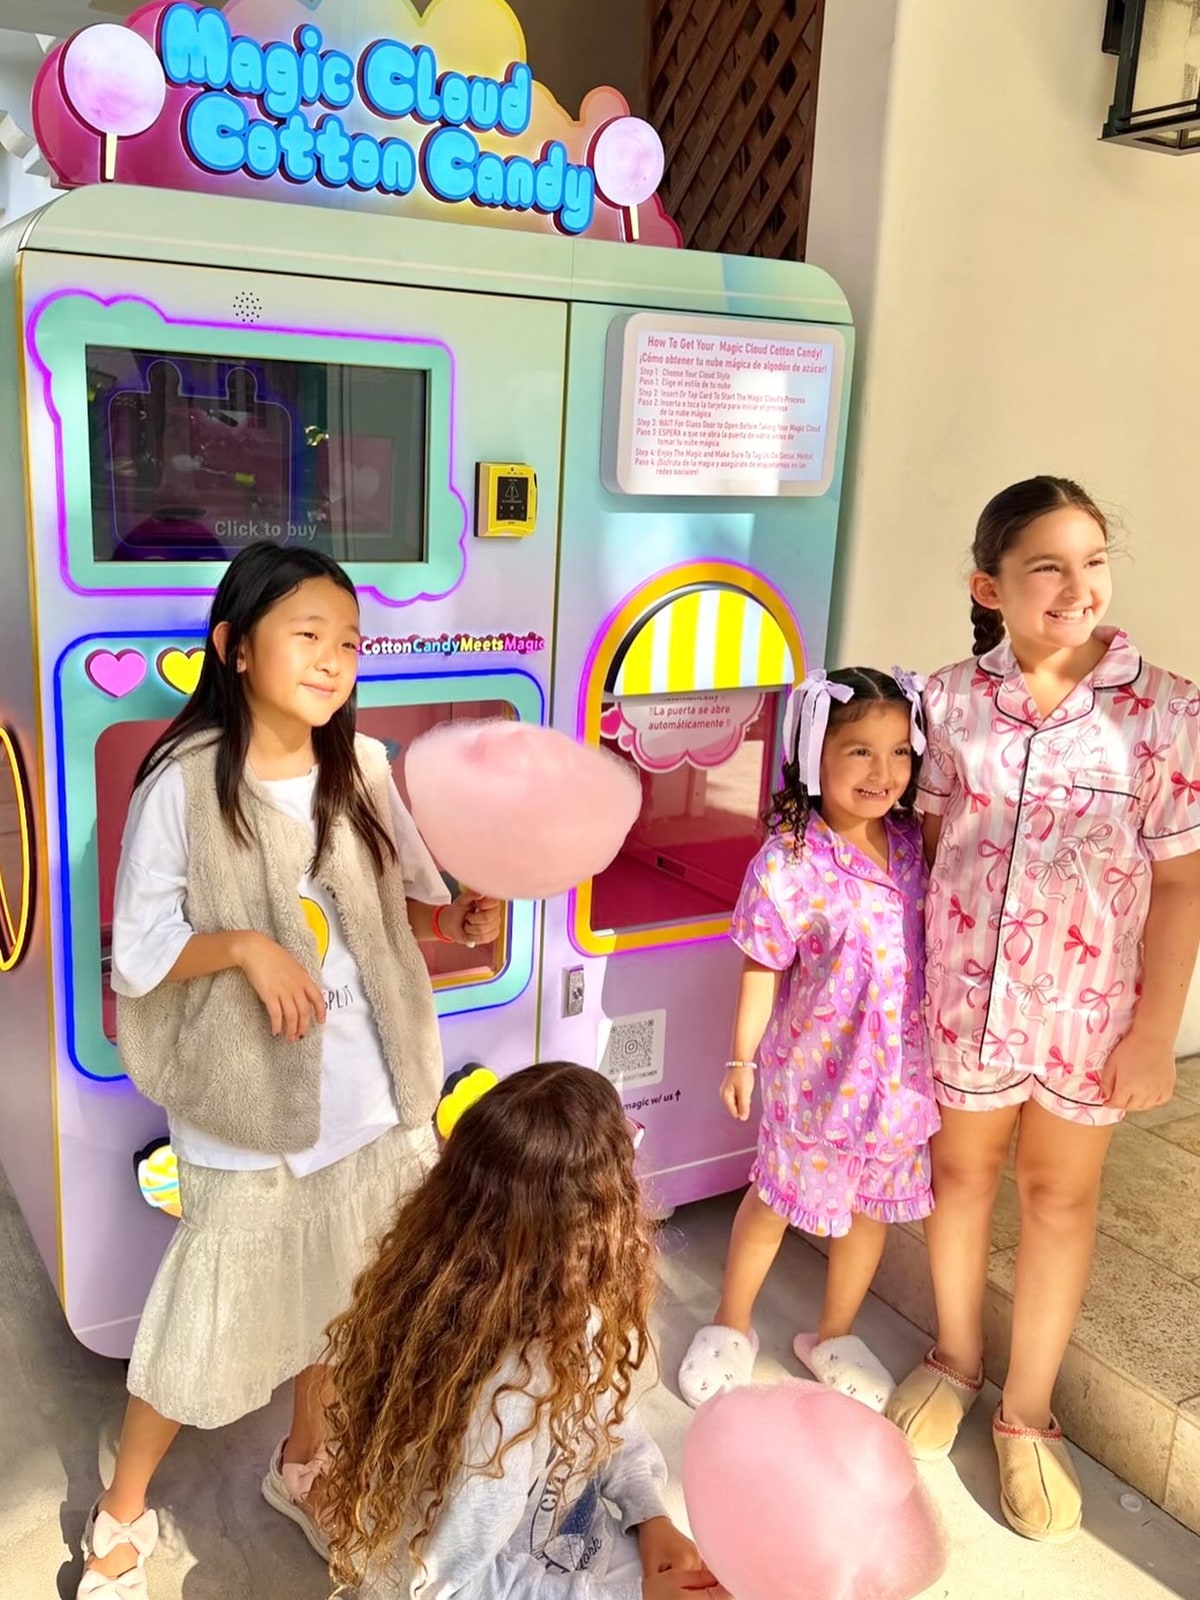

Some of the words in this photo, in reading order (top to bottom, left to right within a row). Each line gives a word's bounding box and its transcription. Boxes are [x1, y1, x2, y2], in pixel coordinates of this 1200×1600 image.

[159, 3, 354, 117] Magic
[361, 38, 532, 134] Cloud
[184, 90, 415, 194] Cotton
[422, 125, 595, 234] Candy
[648, 336, 666, 347] How
[669, 337, 678, 348] To
[680, 338, 694, 349] Get
[696, 340, 714, 350] Your
[720, 341, 743, 355] Magic
[745, 342, 768, 354] Cloud
[770, 344, 795, 356] Cotton
[797, 346, 823, 360] Candy!
[640, 352, 664, 364] ¡Cómo
[665, 354, 694, 365] obtener
[696, 357, 703, 366] tu
[706, 357, 723, 367] nube
[725, 358, 751, 370] mágica
[752, 360, 761, 369] de
[764, 361, 790, 372] algodón
[792, 362, 800, 372] de
[640, 367, 653, 376] Step
[662, 369, 684, 377] Choose
[699, 370, 715, 379] Cloud
[716, 371, 730, 381] Style
[639, 377, 654, 385] Paso
[662, 378, 676, 388] Elige
[639, 388, 652, 397] Step
[688, 391, 698, 400] Tap
[638, 398, 652, 406] Paso
[691, 410, 711, 418] mágica
[637, 418, 650, 427] Step
[724, 422, 738, 430] Open
[635, 448, 648, 457] Step
[214, 520, 258, 536] Click
[264, 522, 281, 536] to
[288, 520, 317, 540] buy
[667, 706, 696, 717] puerta
[711, 704, 730, 714] abre
[648, 719, 724, 730] automáticamente
[651, 1094, 662, 1104] w/
